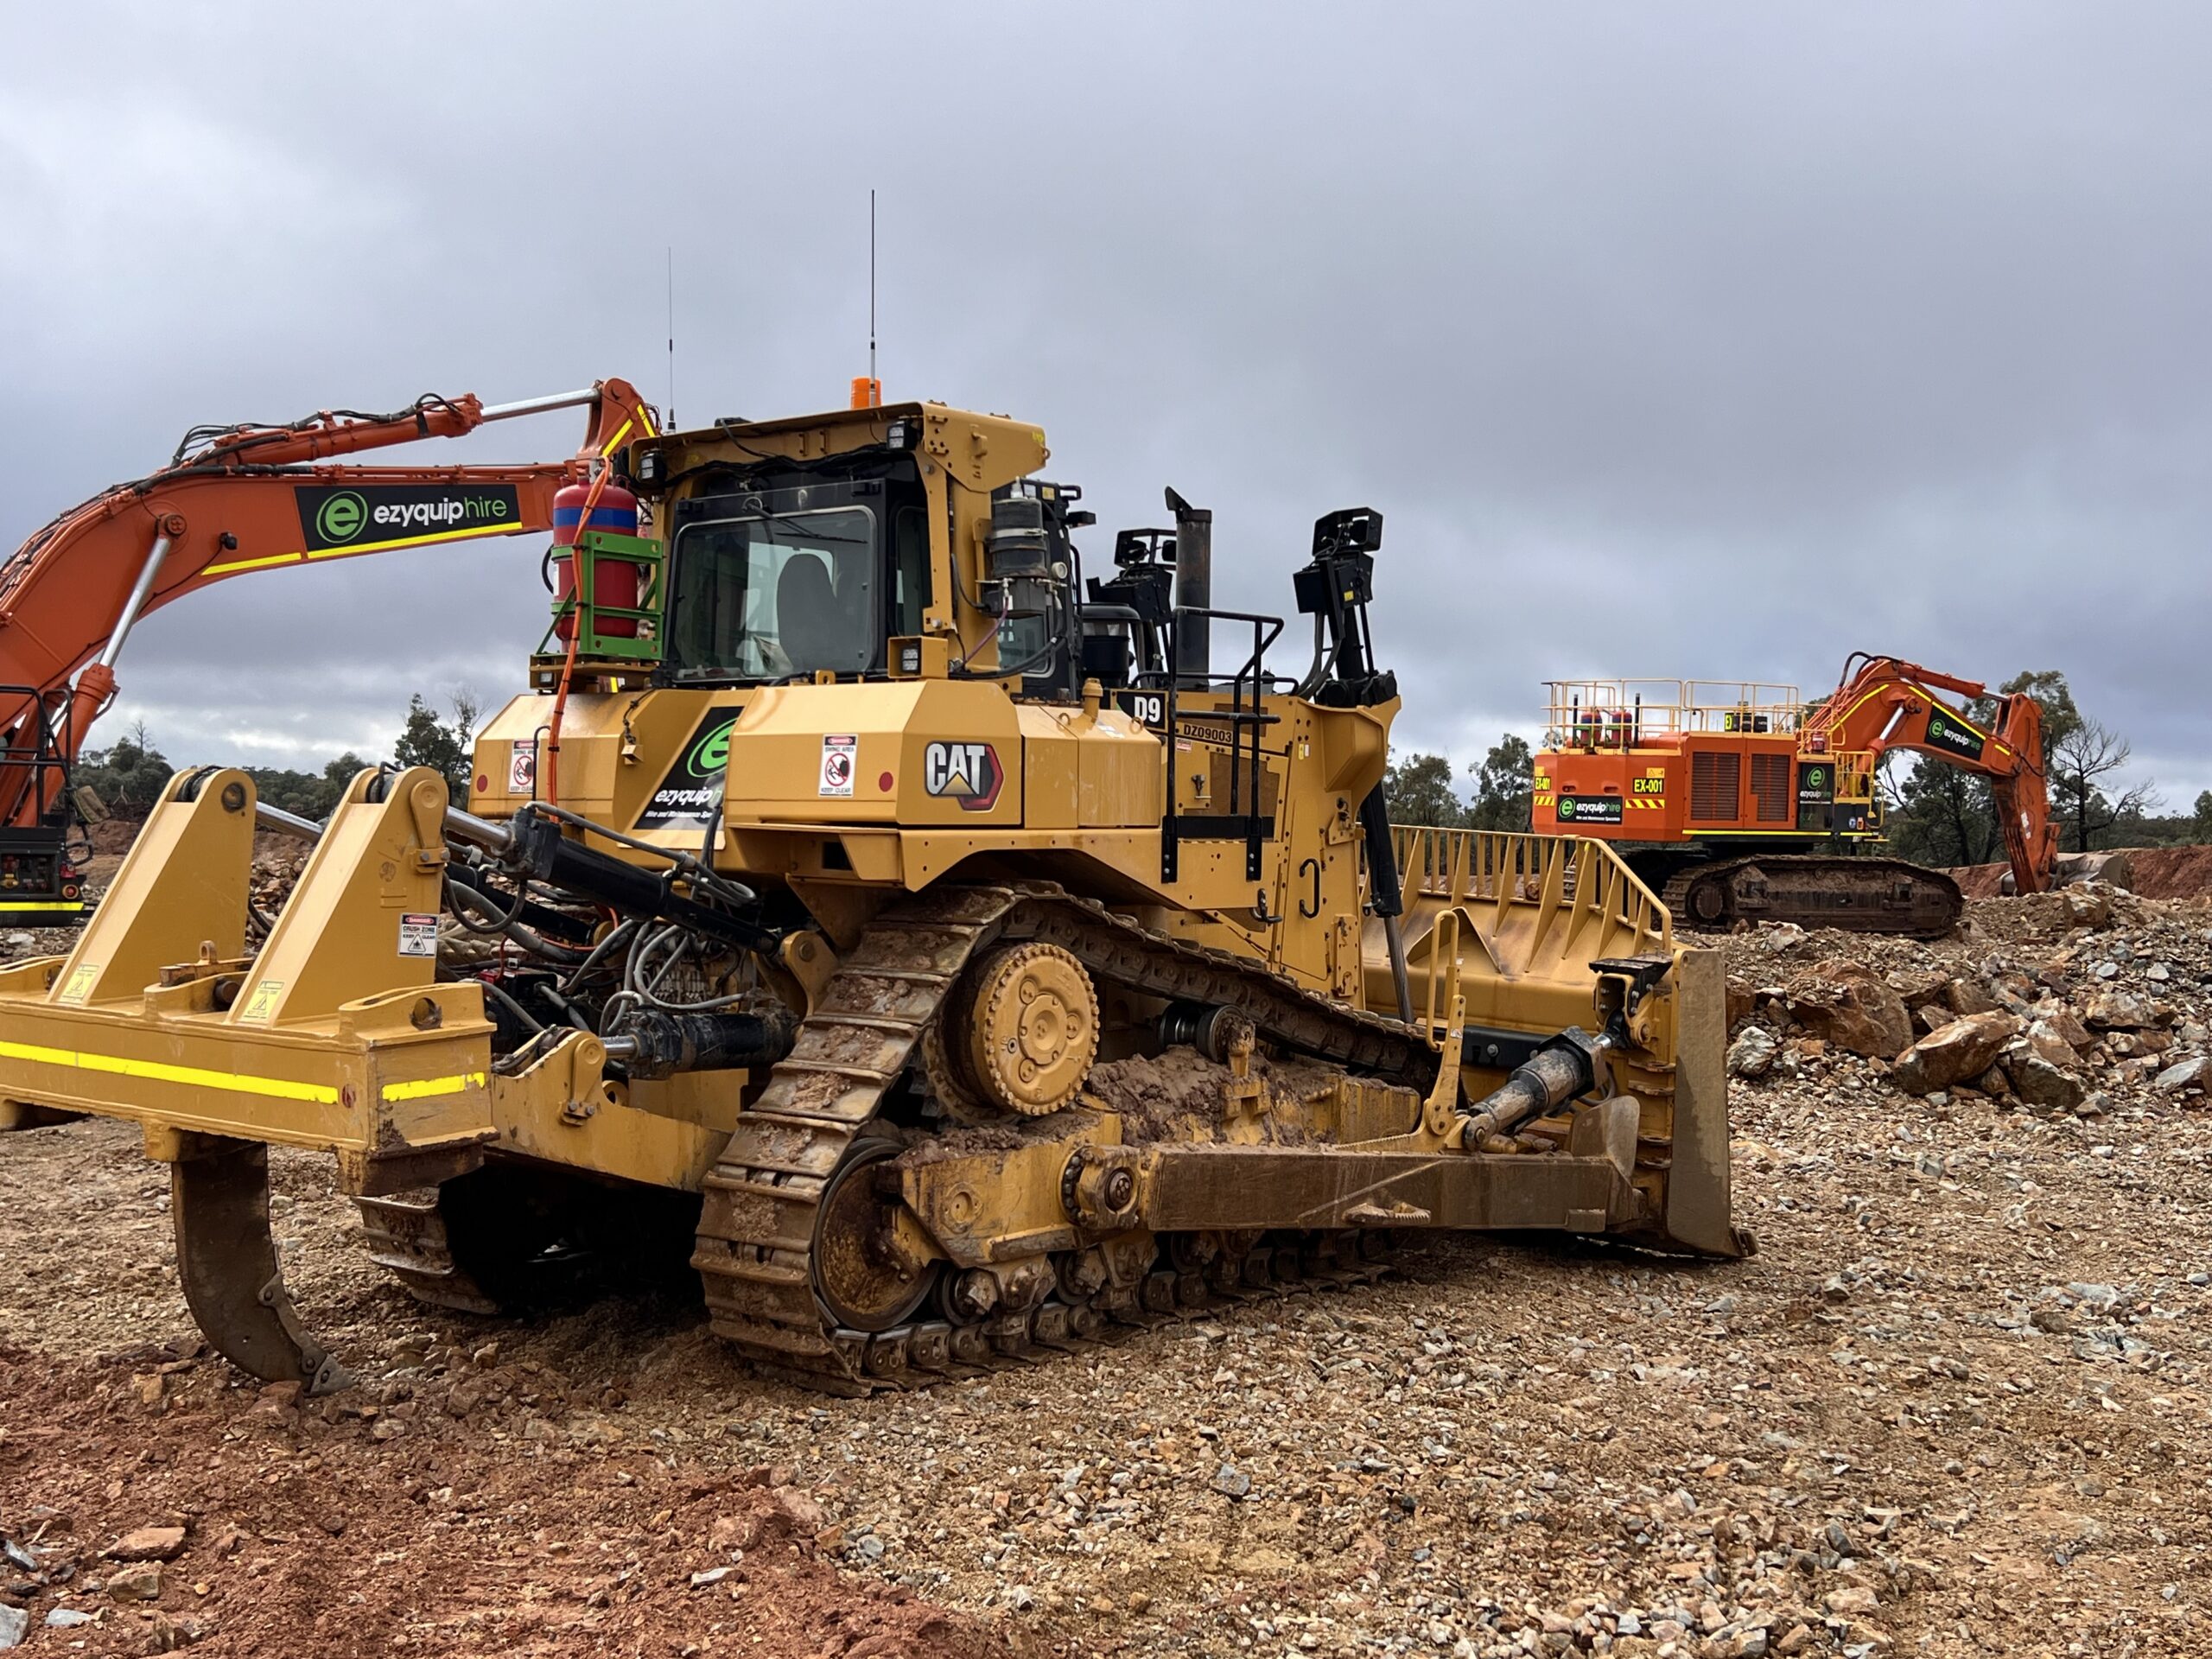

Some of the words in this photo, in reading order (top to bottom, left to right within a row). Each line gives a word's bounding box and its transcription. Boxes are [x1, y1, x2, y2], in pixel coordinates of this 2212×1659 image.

[373, 496, 507, 528] ezyquiphire
[1134, 696, 1160, 723] D9
[926, 743, 985, 795] CAT
[1535, 777, 1550, 791] EX-001
[1634, 779, 1662, 792] EX-001
[1576, 802, 1621, 814] ezyquiphire
